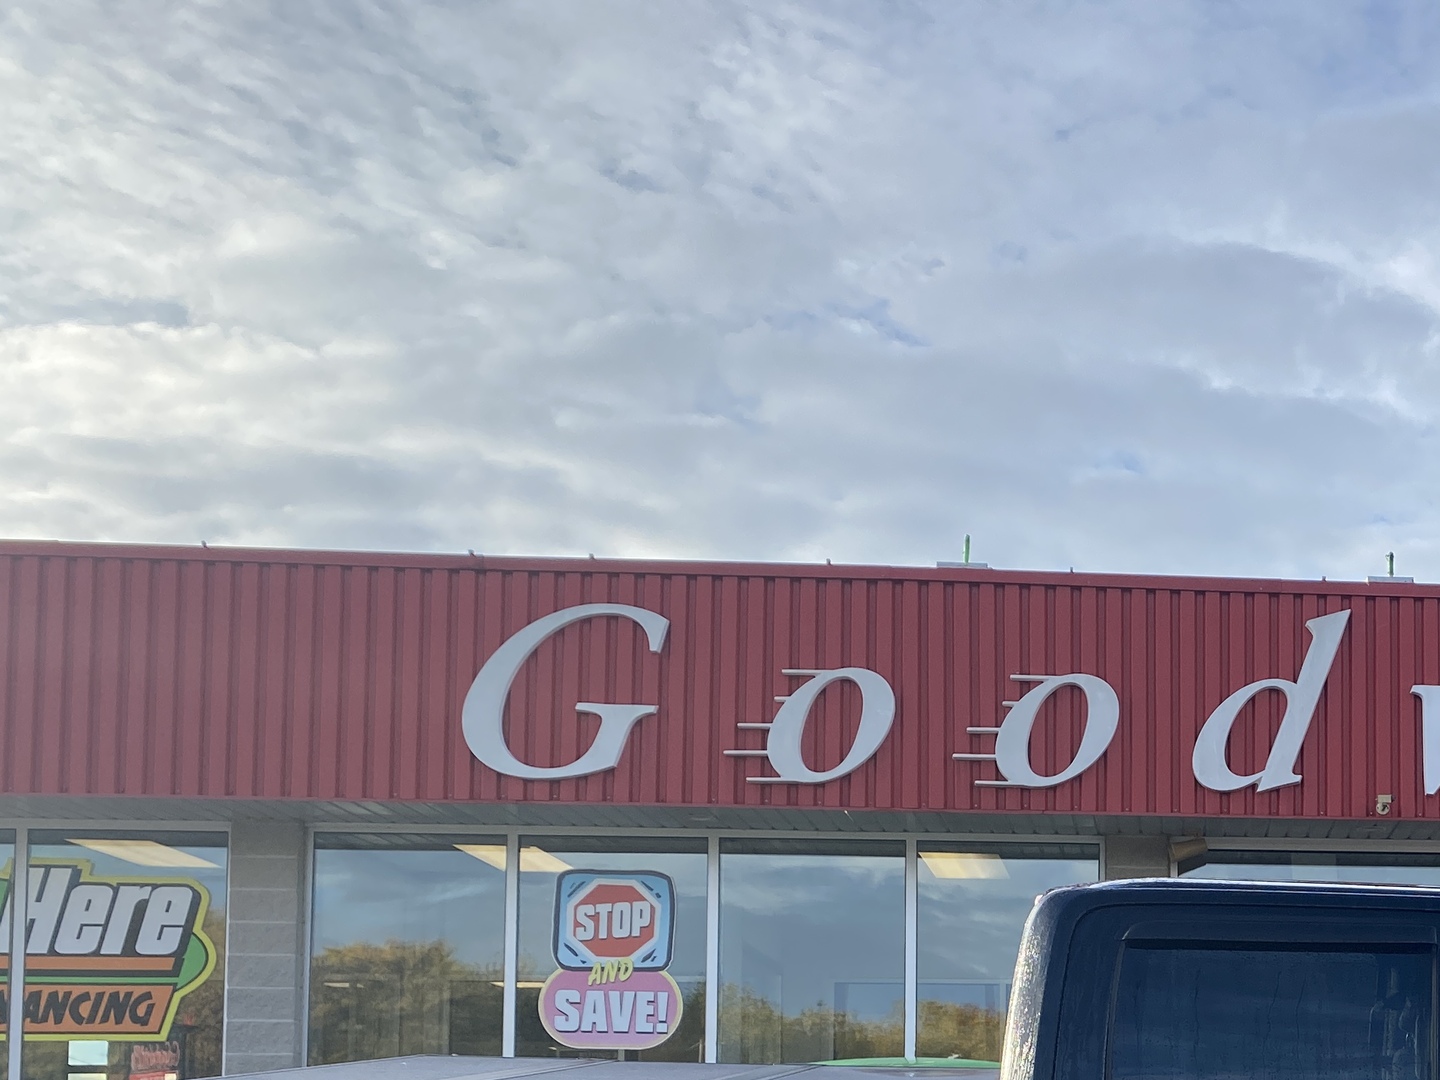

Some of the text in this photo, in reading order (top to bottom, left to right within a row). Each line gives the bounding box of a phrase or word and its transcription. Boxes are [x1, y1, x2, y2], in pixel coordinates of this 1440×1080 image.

[0, 866, 194, 955] Here
[575, 901, 651, 941] STOP
[588, 958, 634, 986] AND
[554, 989, 669, 1034] SAVE!
